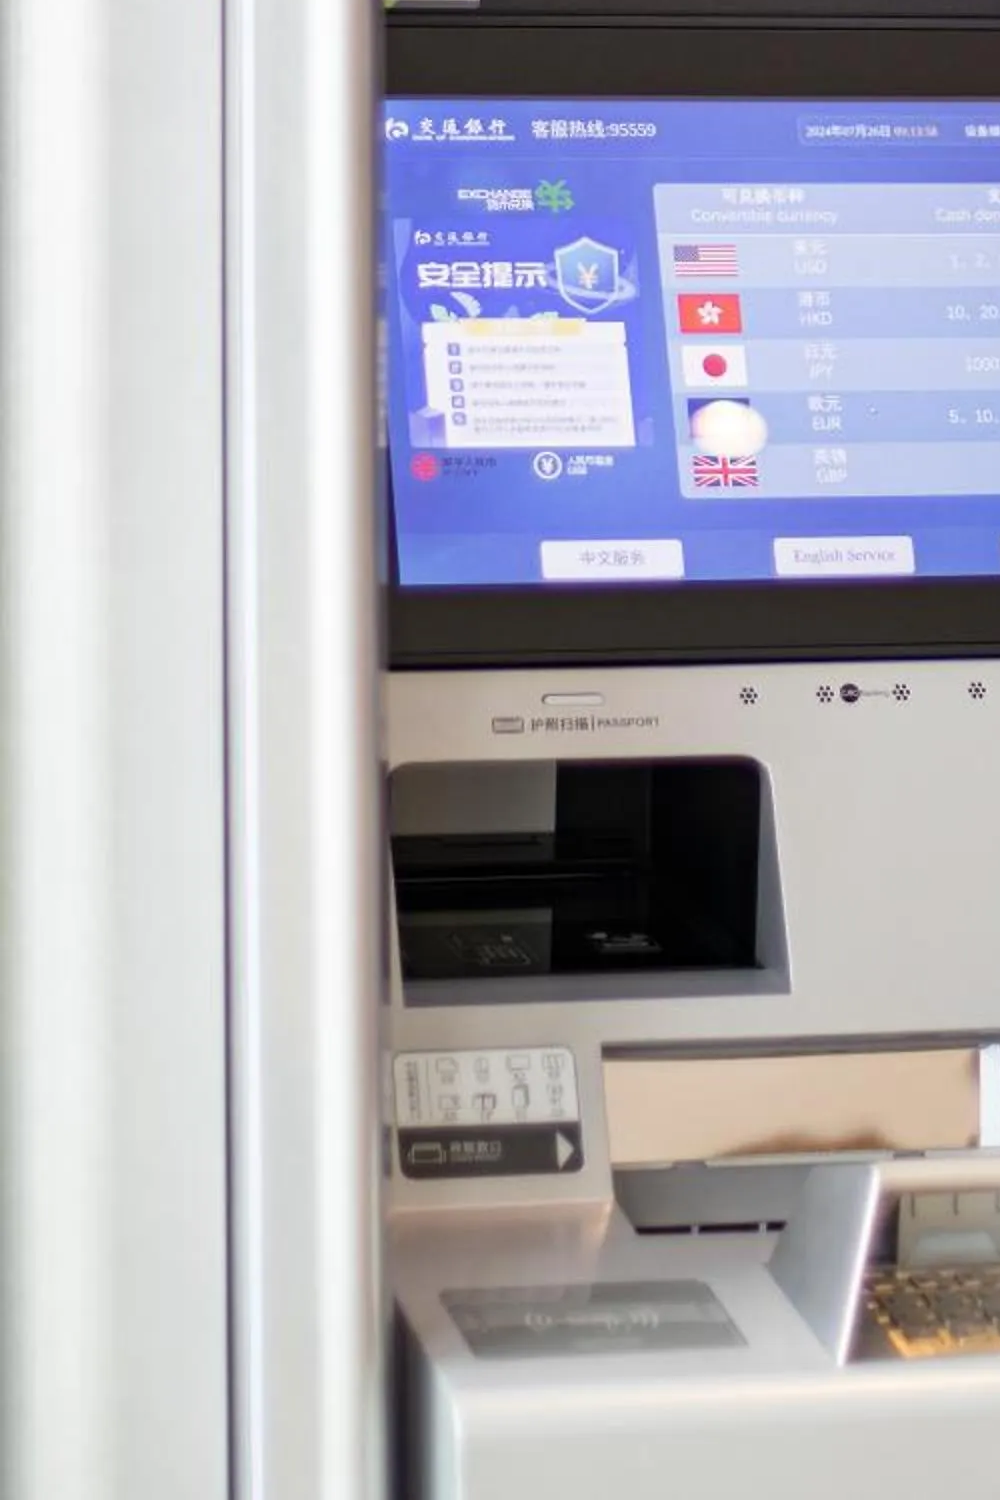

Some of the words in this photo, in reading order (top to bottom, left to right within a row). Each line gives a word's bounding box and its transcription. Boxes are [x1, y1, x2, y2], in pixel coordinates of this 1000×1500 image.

[416, 260, 549, 289] 安全提示
[792, 547, 843, 566] English
[846, 546, 897, 562] Service
